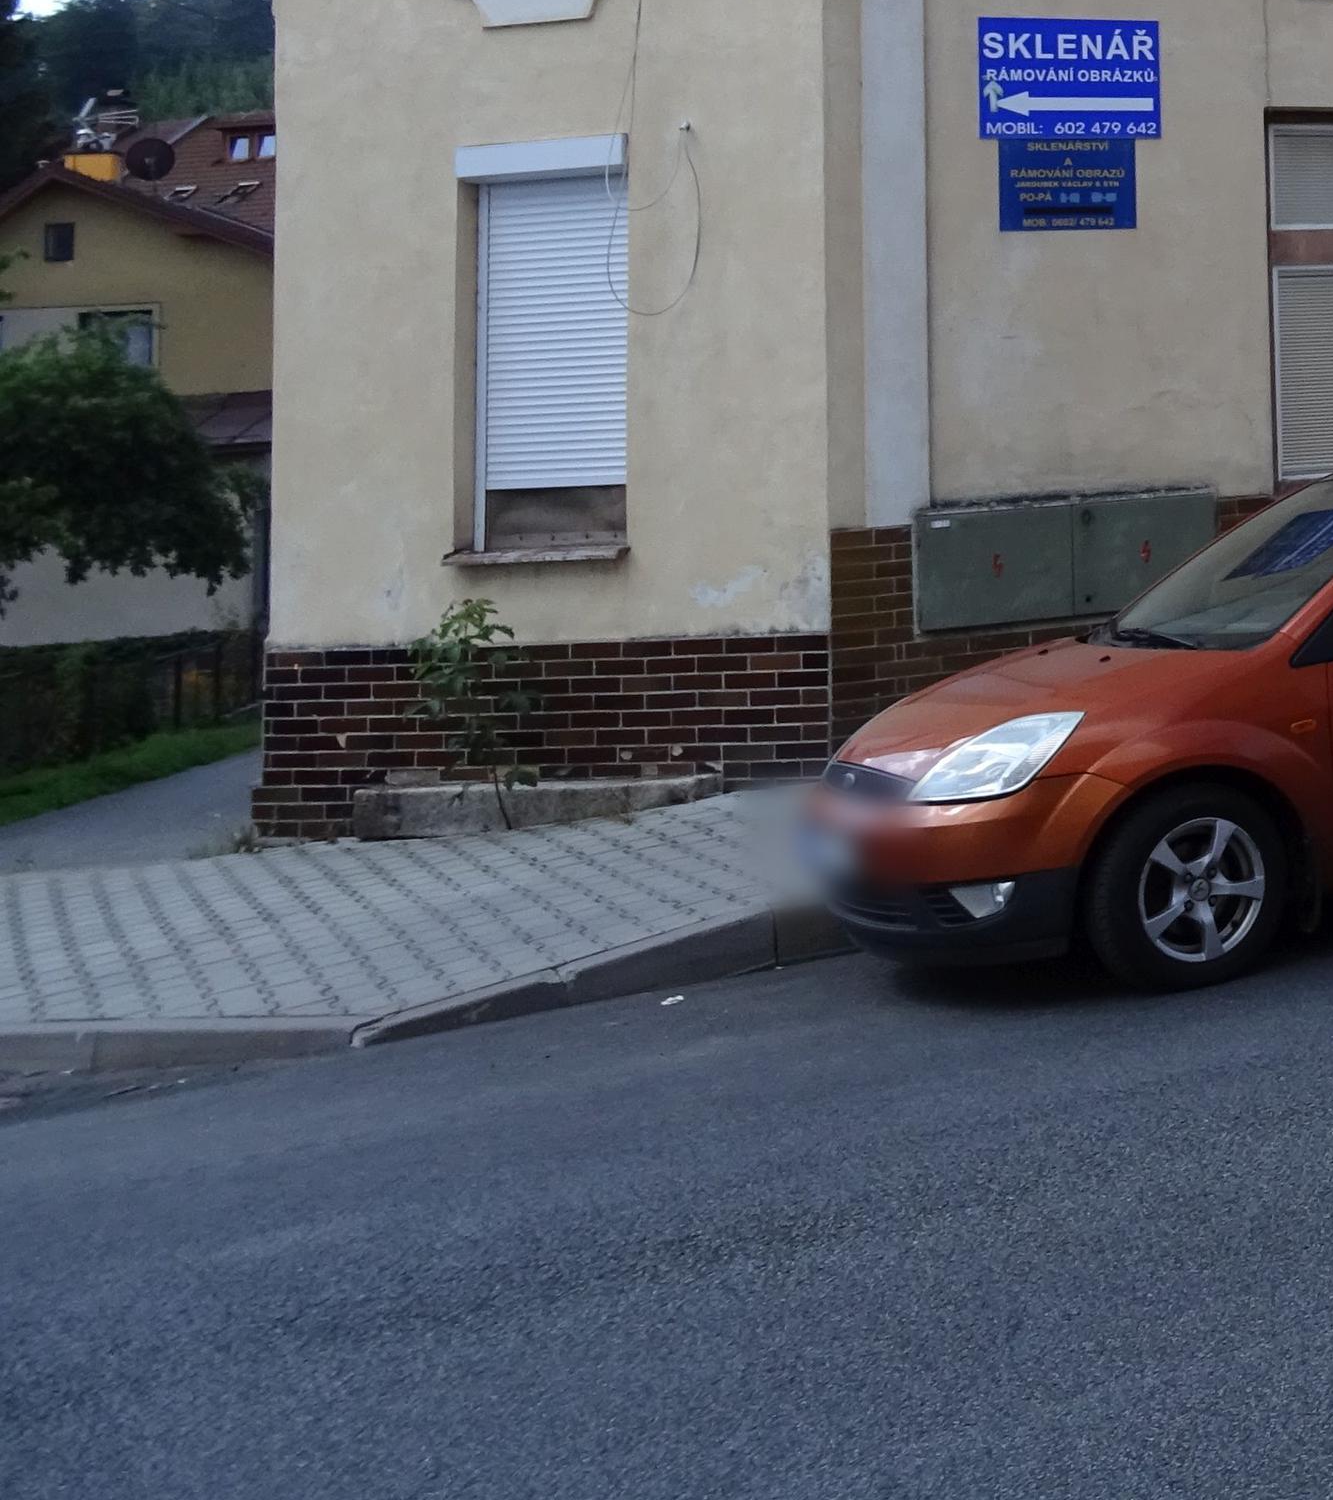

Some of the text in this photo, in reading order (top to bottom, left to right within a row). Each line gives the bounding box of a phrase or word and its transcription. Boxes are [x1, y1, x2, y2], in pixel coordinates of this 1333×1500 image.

[982, 29, 1155, 60] SKLENÁŘ
[986, 66, 1154, 82] RÁMOVÁNÍ OBRÁZKŮ
[986, 122, 1157, 134] MOBIL: 602 479 642
[1063, 157, 1073, 166] A
